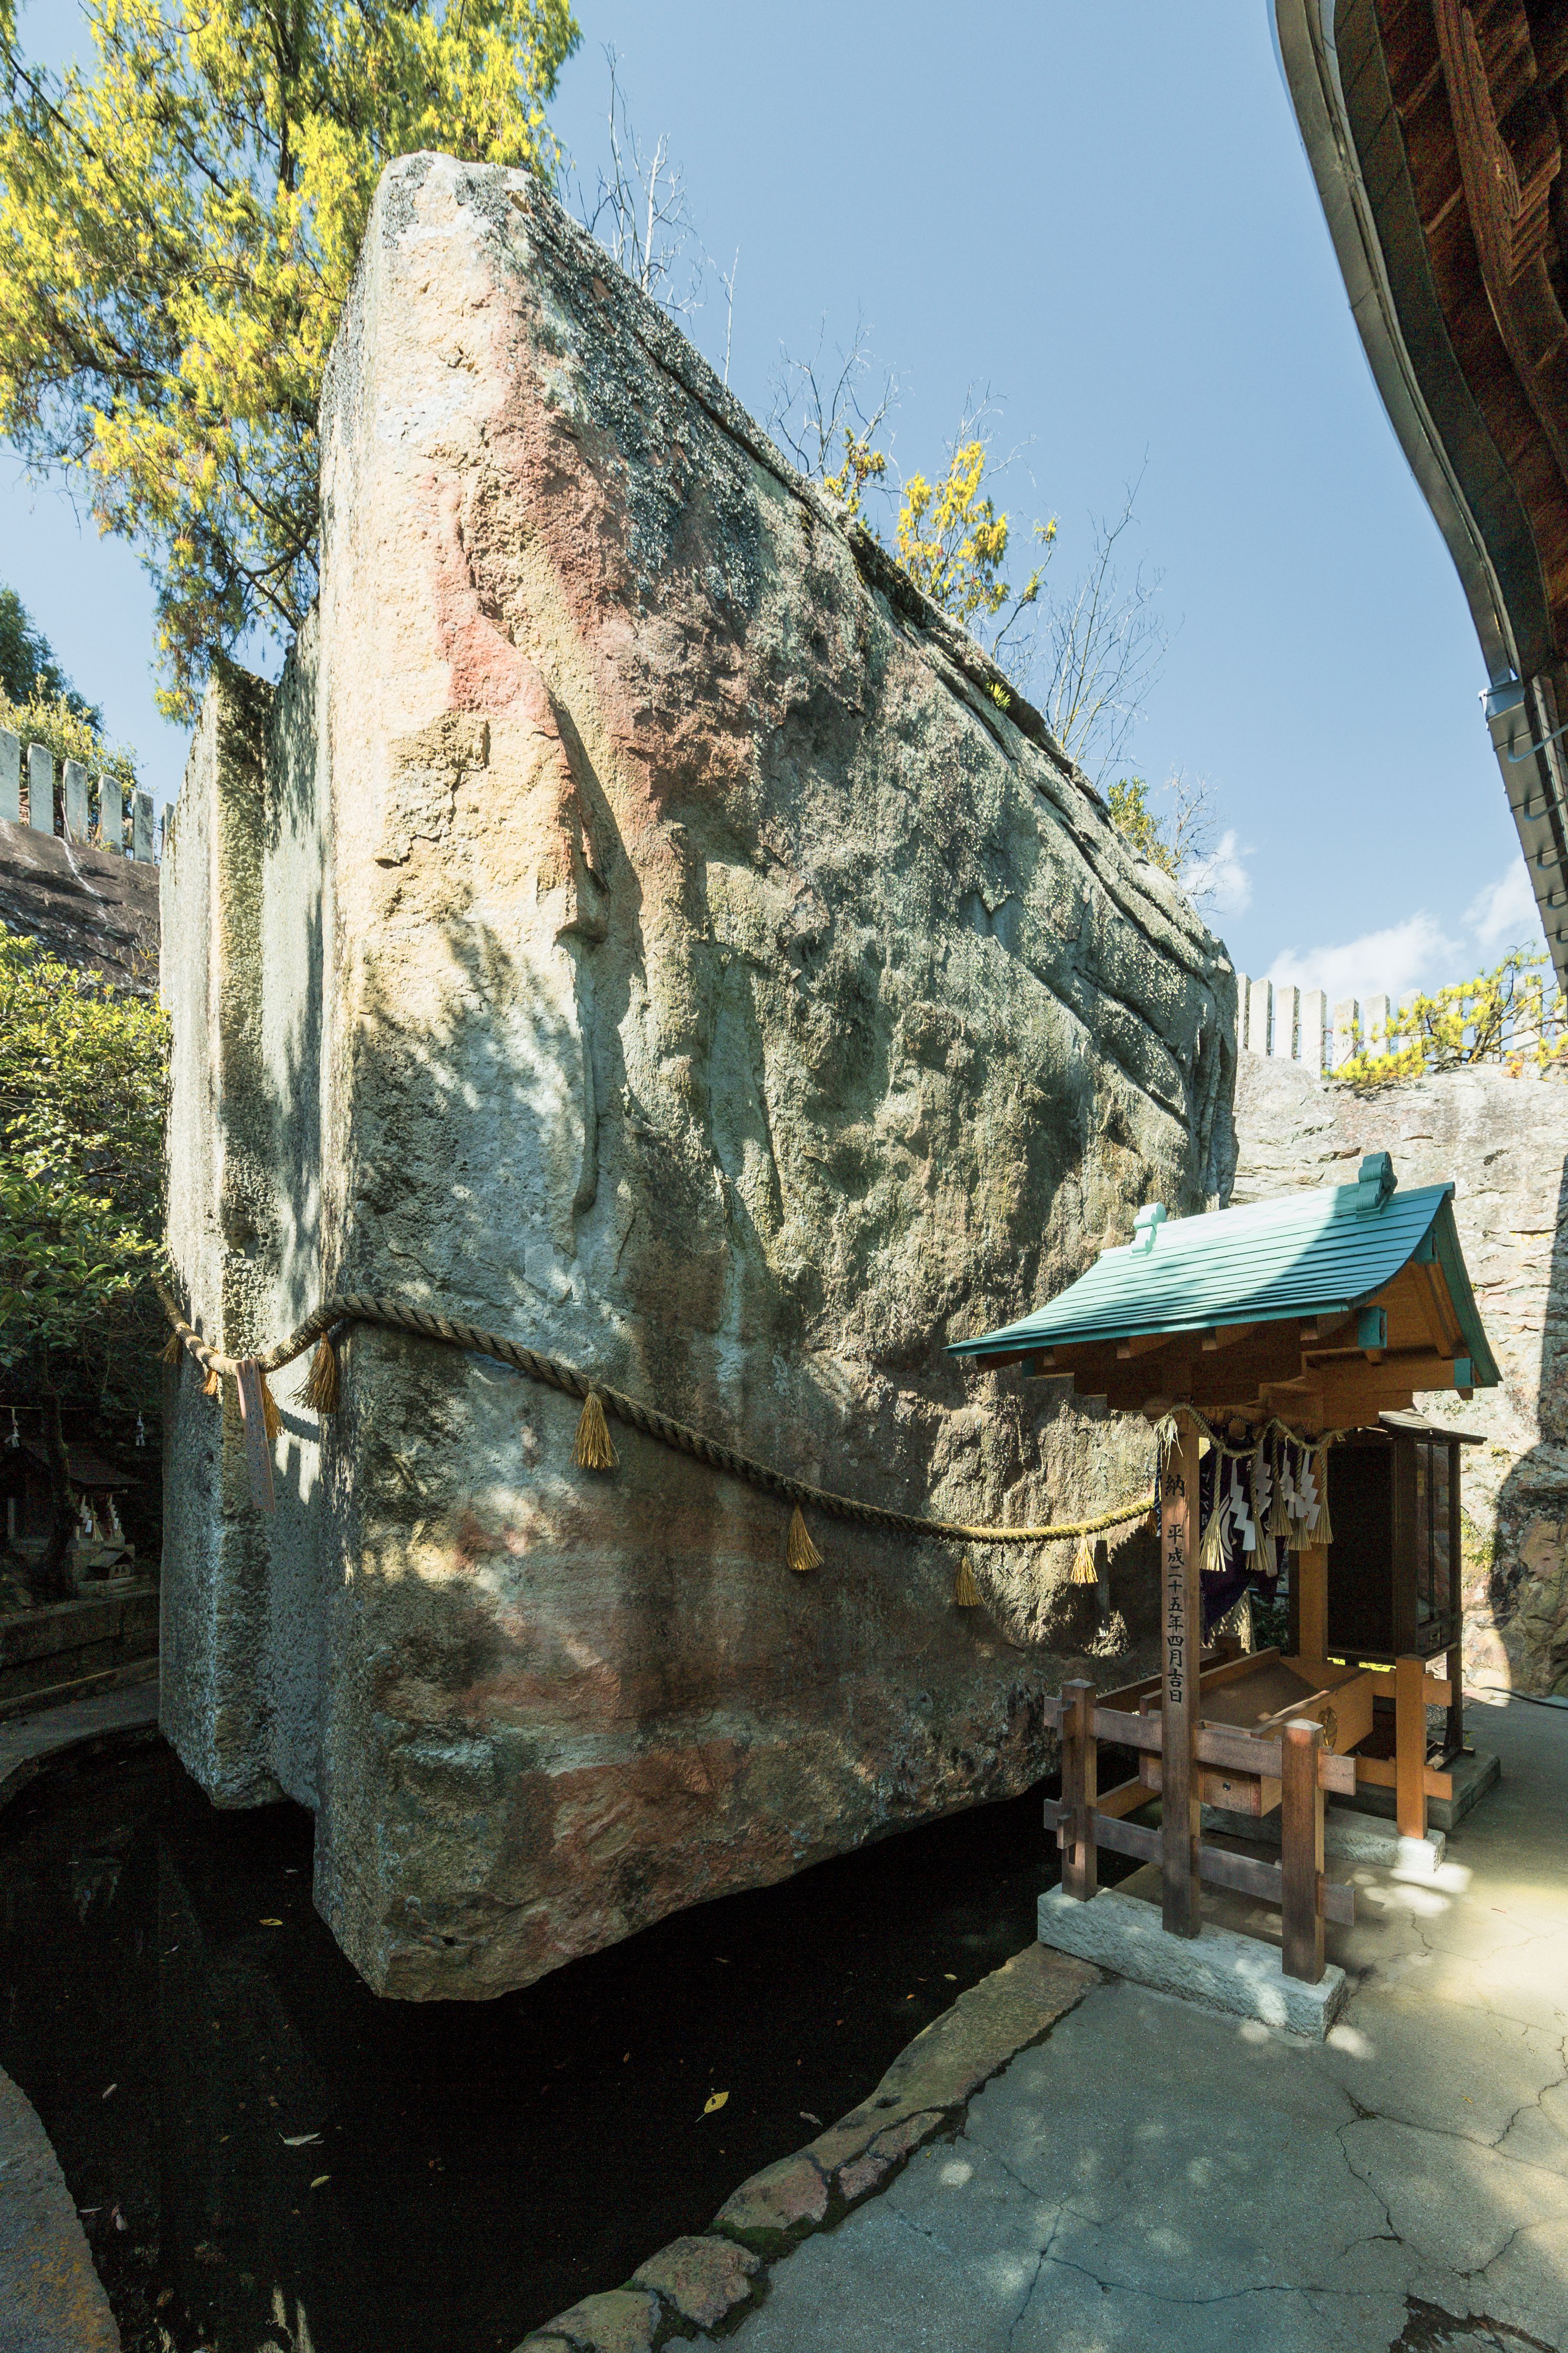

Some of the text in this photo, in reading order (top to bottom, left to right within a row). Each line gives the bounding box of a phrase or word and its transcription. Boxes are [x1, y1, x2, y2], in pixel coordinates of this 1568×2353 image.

[1165, 1474, 1185, 1704] 納 平成二十五年四月吉日
